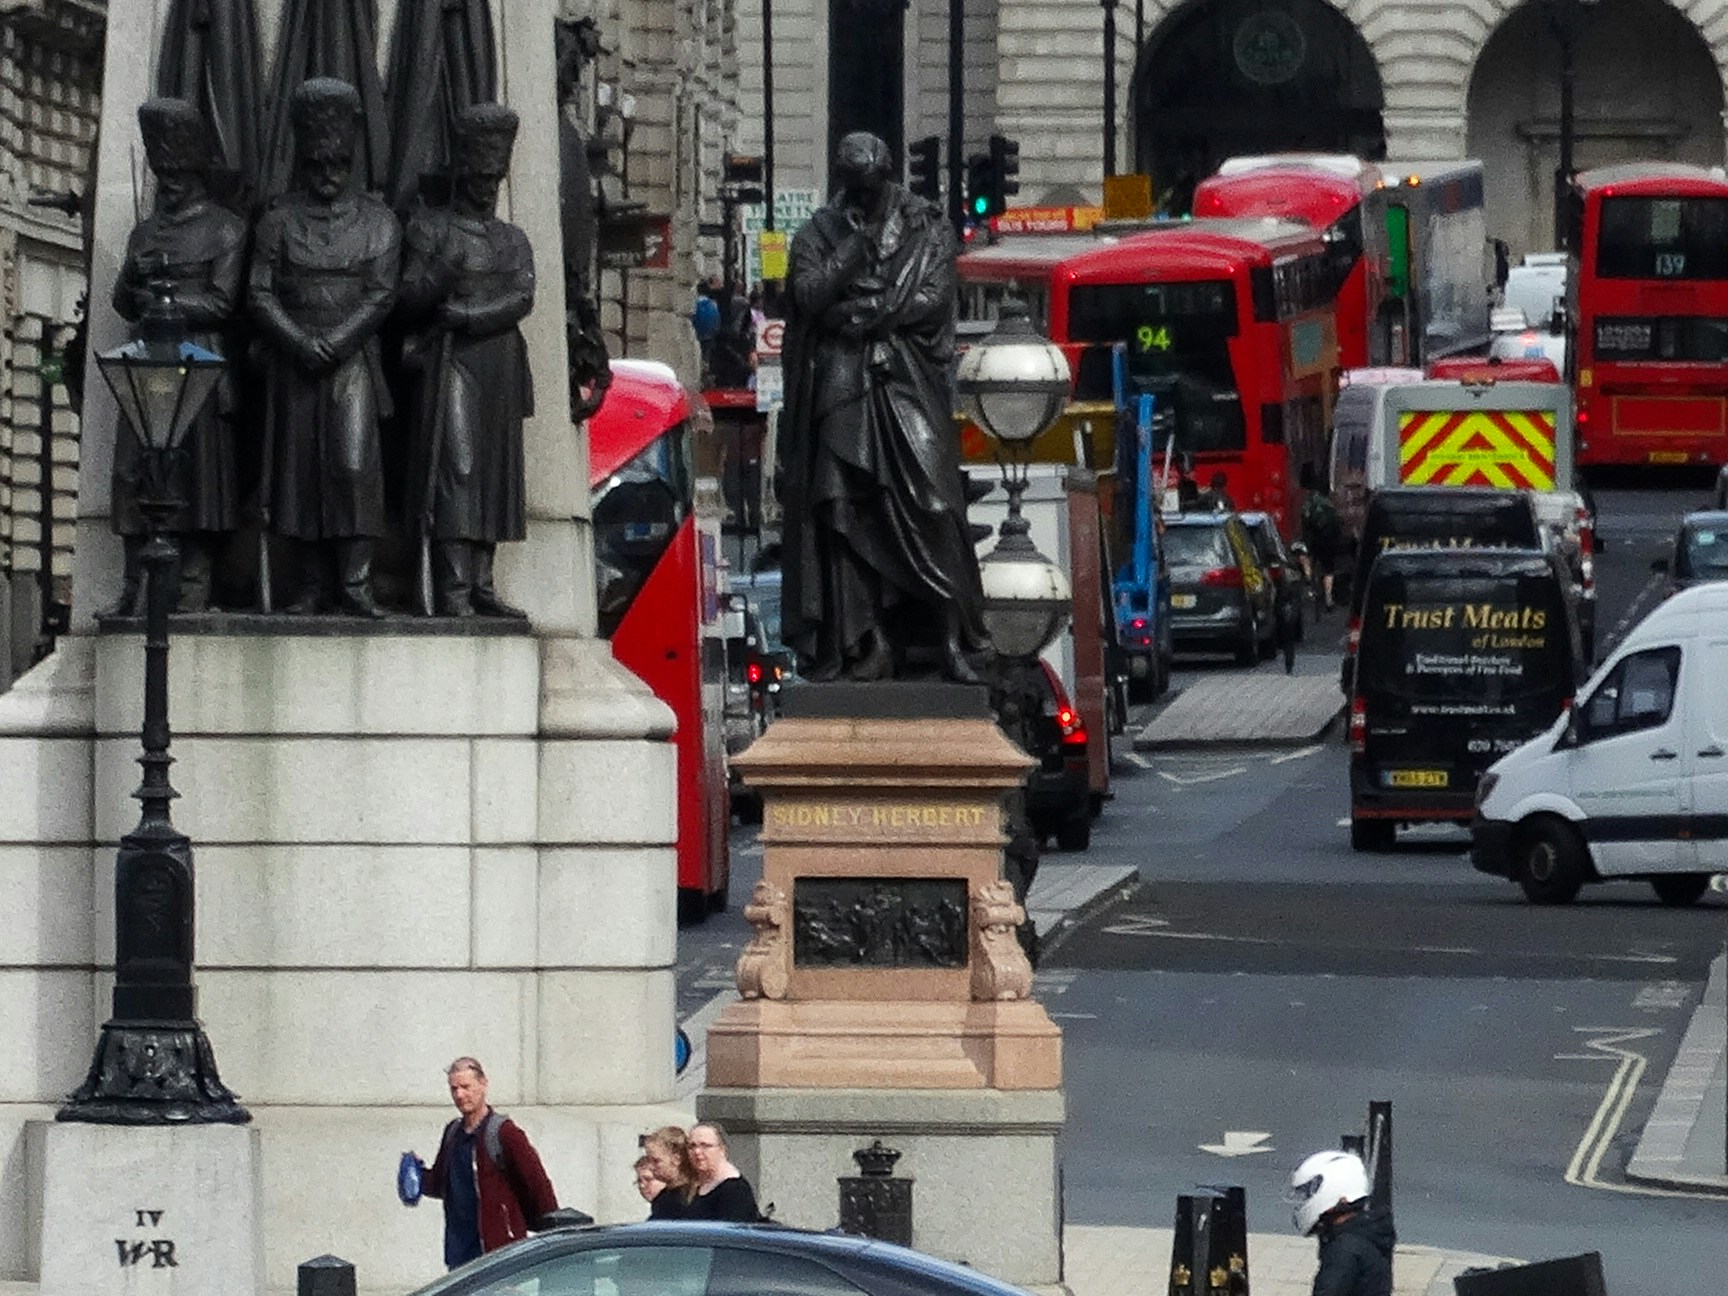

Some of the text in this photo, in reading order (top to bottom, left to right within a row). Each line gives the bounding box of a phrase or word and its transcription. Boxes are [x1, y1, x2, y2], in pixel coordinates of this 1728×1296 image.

[1656, 254, 1686, 275] 139
[1137, 326, 1170, 351] 94
[1384, 604, 1547, 630] Trust Meats
[1491, 635, 1546, 650] London
[772, 806, 985, 827] SIDNEY HERBERT
[135, 1209, 165, 1228] IV
